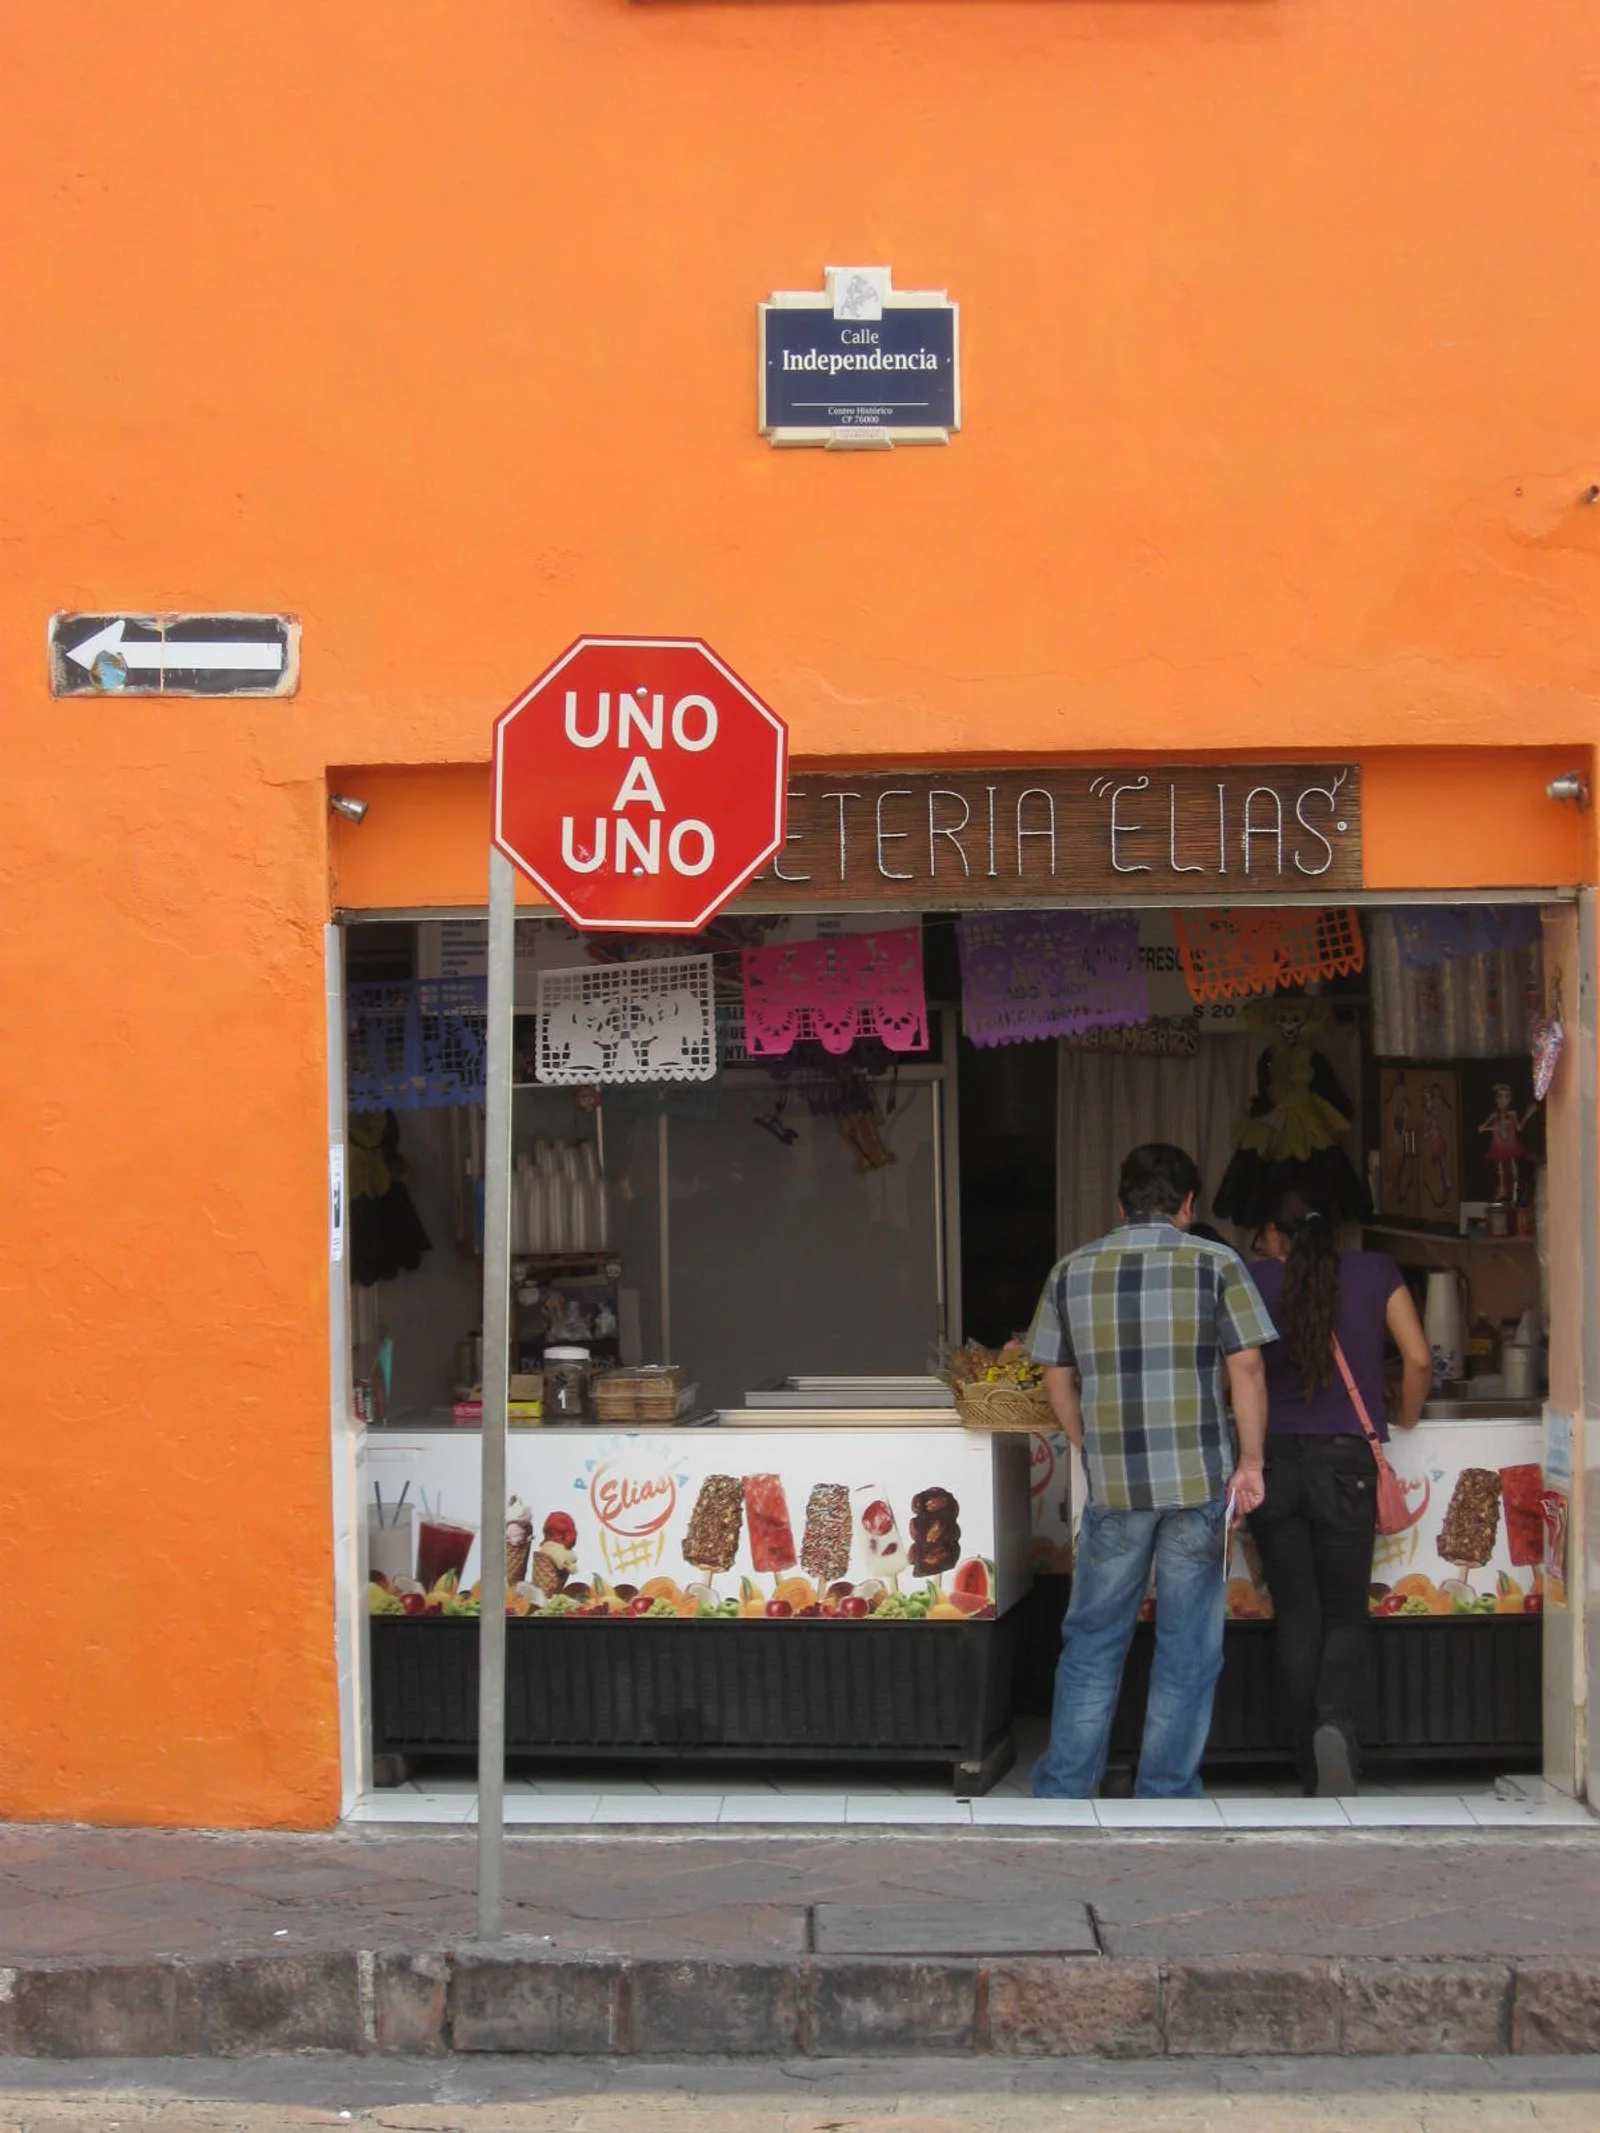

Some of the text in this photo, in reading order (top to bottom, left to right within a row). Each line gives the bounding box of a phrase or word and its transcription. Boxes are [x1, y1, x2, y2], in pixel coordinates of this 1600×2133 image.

[782, 347, 938, 375] Independencia
[840, 328, 880, 345] Calle
[828, 406, 855, 416] Centro
[564, 691, 718, 752] UNO
[611, 756, 666, 812] A
[561, 816, 716, 877] UNO
[753, 786, 1055, 881] ETERIA
[600, 1477, 668, 1522] Elias
